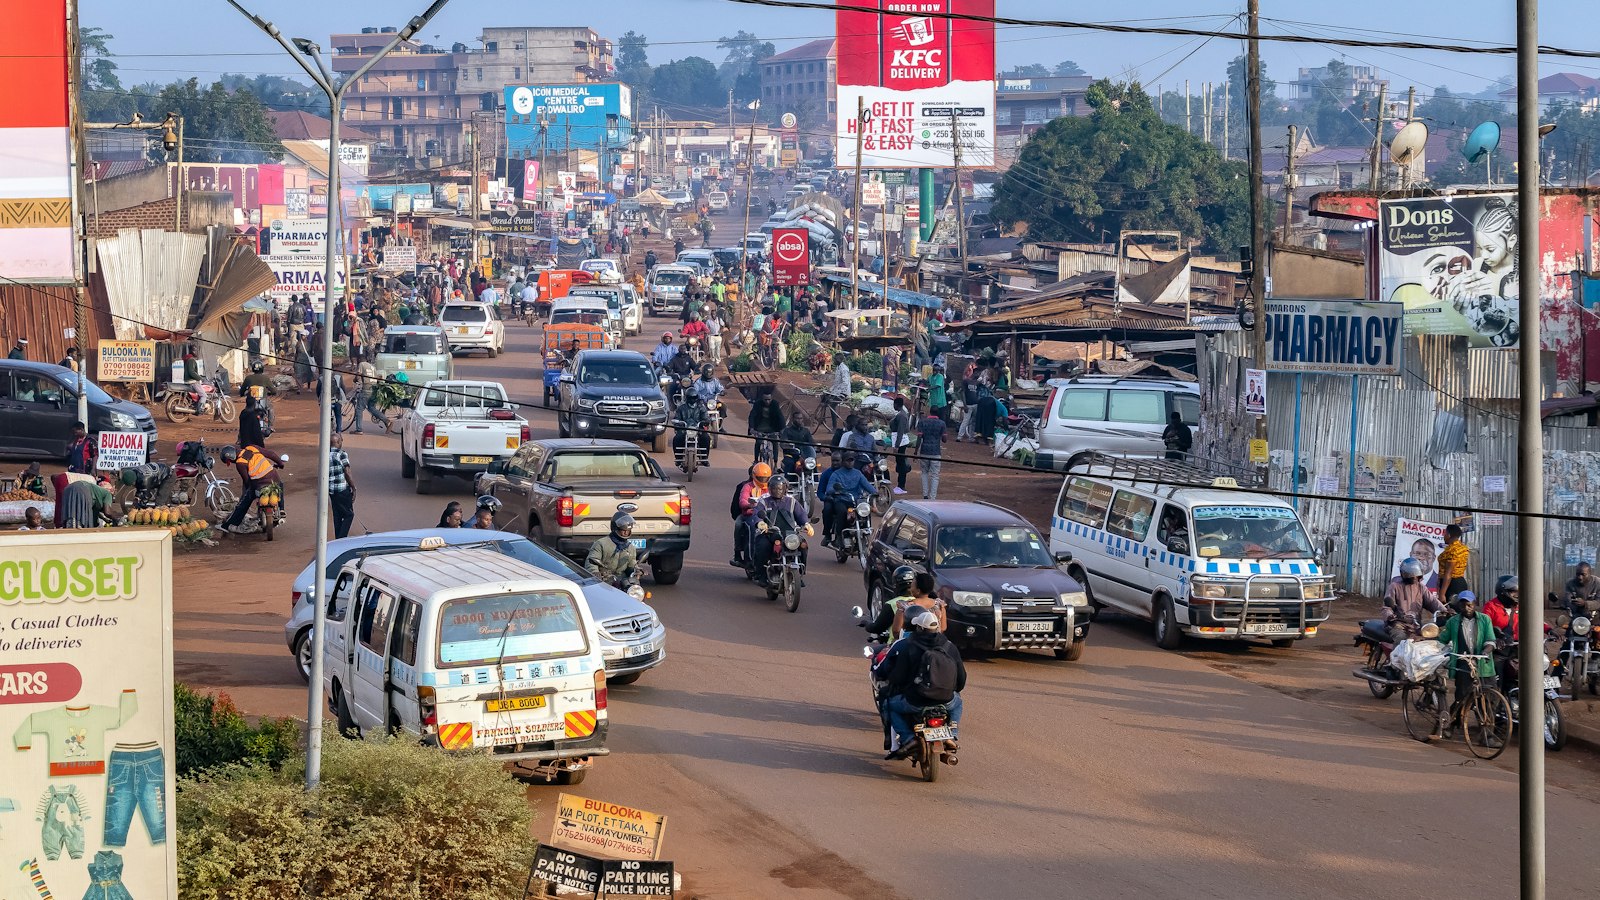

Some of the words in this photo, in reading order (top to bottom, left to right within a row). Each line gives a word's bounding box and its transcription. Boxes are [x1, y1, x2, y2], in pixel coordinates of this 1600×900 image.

[891, 50, 941, 66] KFC
[891, 68, 941, 79] DELIVERY
[532, 87, 551, 96] ICON
[553, 87, 590, 96] MEDICAL
[545, 96, 578, 105] CENTRE
[872, 102, 896, 116] GET
[901, 102, 914, 116] IT
[882, 118, 914, 134] FAST
[933, 130, 949, 138] +256
[974, 130, 985, 138] 156
[864, 135, 875, 150] &
[879, 135, 914, 150] EASY
[491, 217, 512, 225] Bread
[514, 216, 535, 225] Point
[1389, 206, 1454, 227] Dons
[271, 232, 328, 240] PHARMACY
[780, 241, 801, 250] absa
[102, 347, 138, 356] BULOOKA
[140, 348, 152, 356] WA
[101, 434, 143, 450] BULOOKA
[1402, 530, 1431, 539] EMMANUEL
[0, 557, 138, 601] CLOSET
[11, 616, 60, 630] Casual
[65, 614, 118, 628] Clothes
[1032, 623, 1050, 631] 283U
[15, 637, 82, 650] deliveries
[519, 698, 540, 708] 800V
[560, 807, 573, 817] WA
[584, 800, 642, 820] BULOOKA
[582, 824, 643, 845] NAMAYUMBA
[556, 852, 576, 864] NO
[537, 858, 598, 883] PARKING
[621, 861, 640, 870] NO
[533, 869, 562, 884] POLICE
[564, 877, 595, 892] NOTICE
[606, 871, 670, 884] PARKING
[604, 884, 633, 894] POLICE
[637, 885, 671, 895] NOTICE
